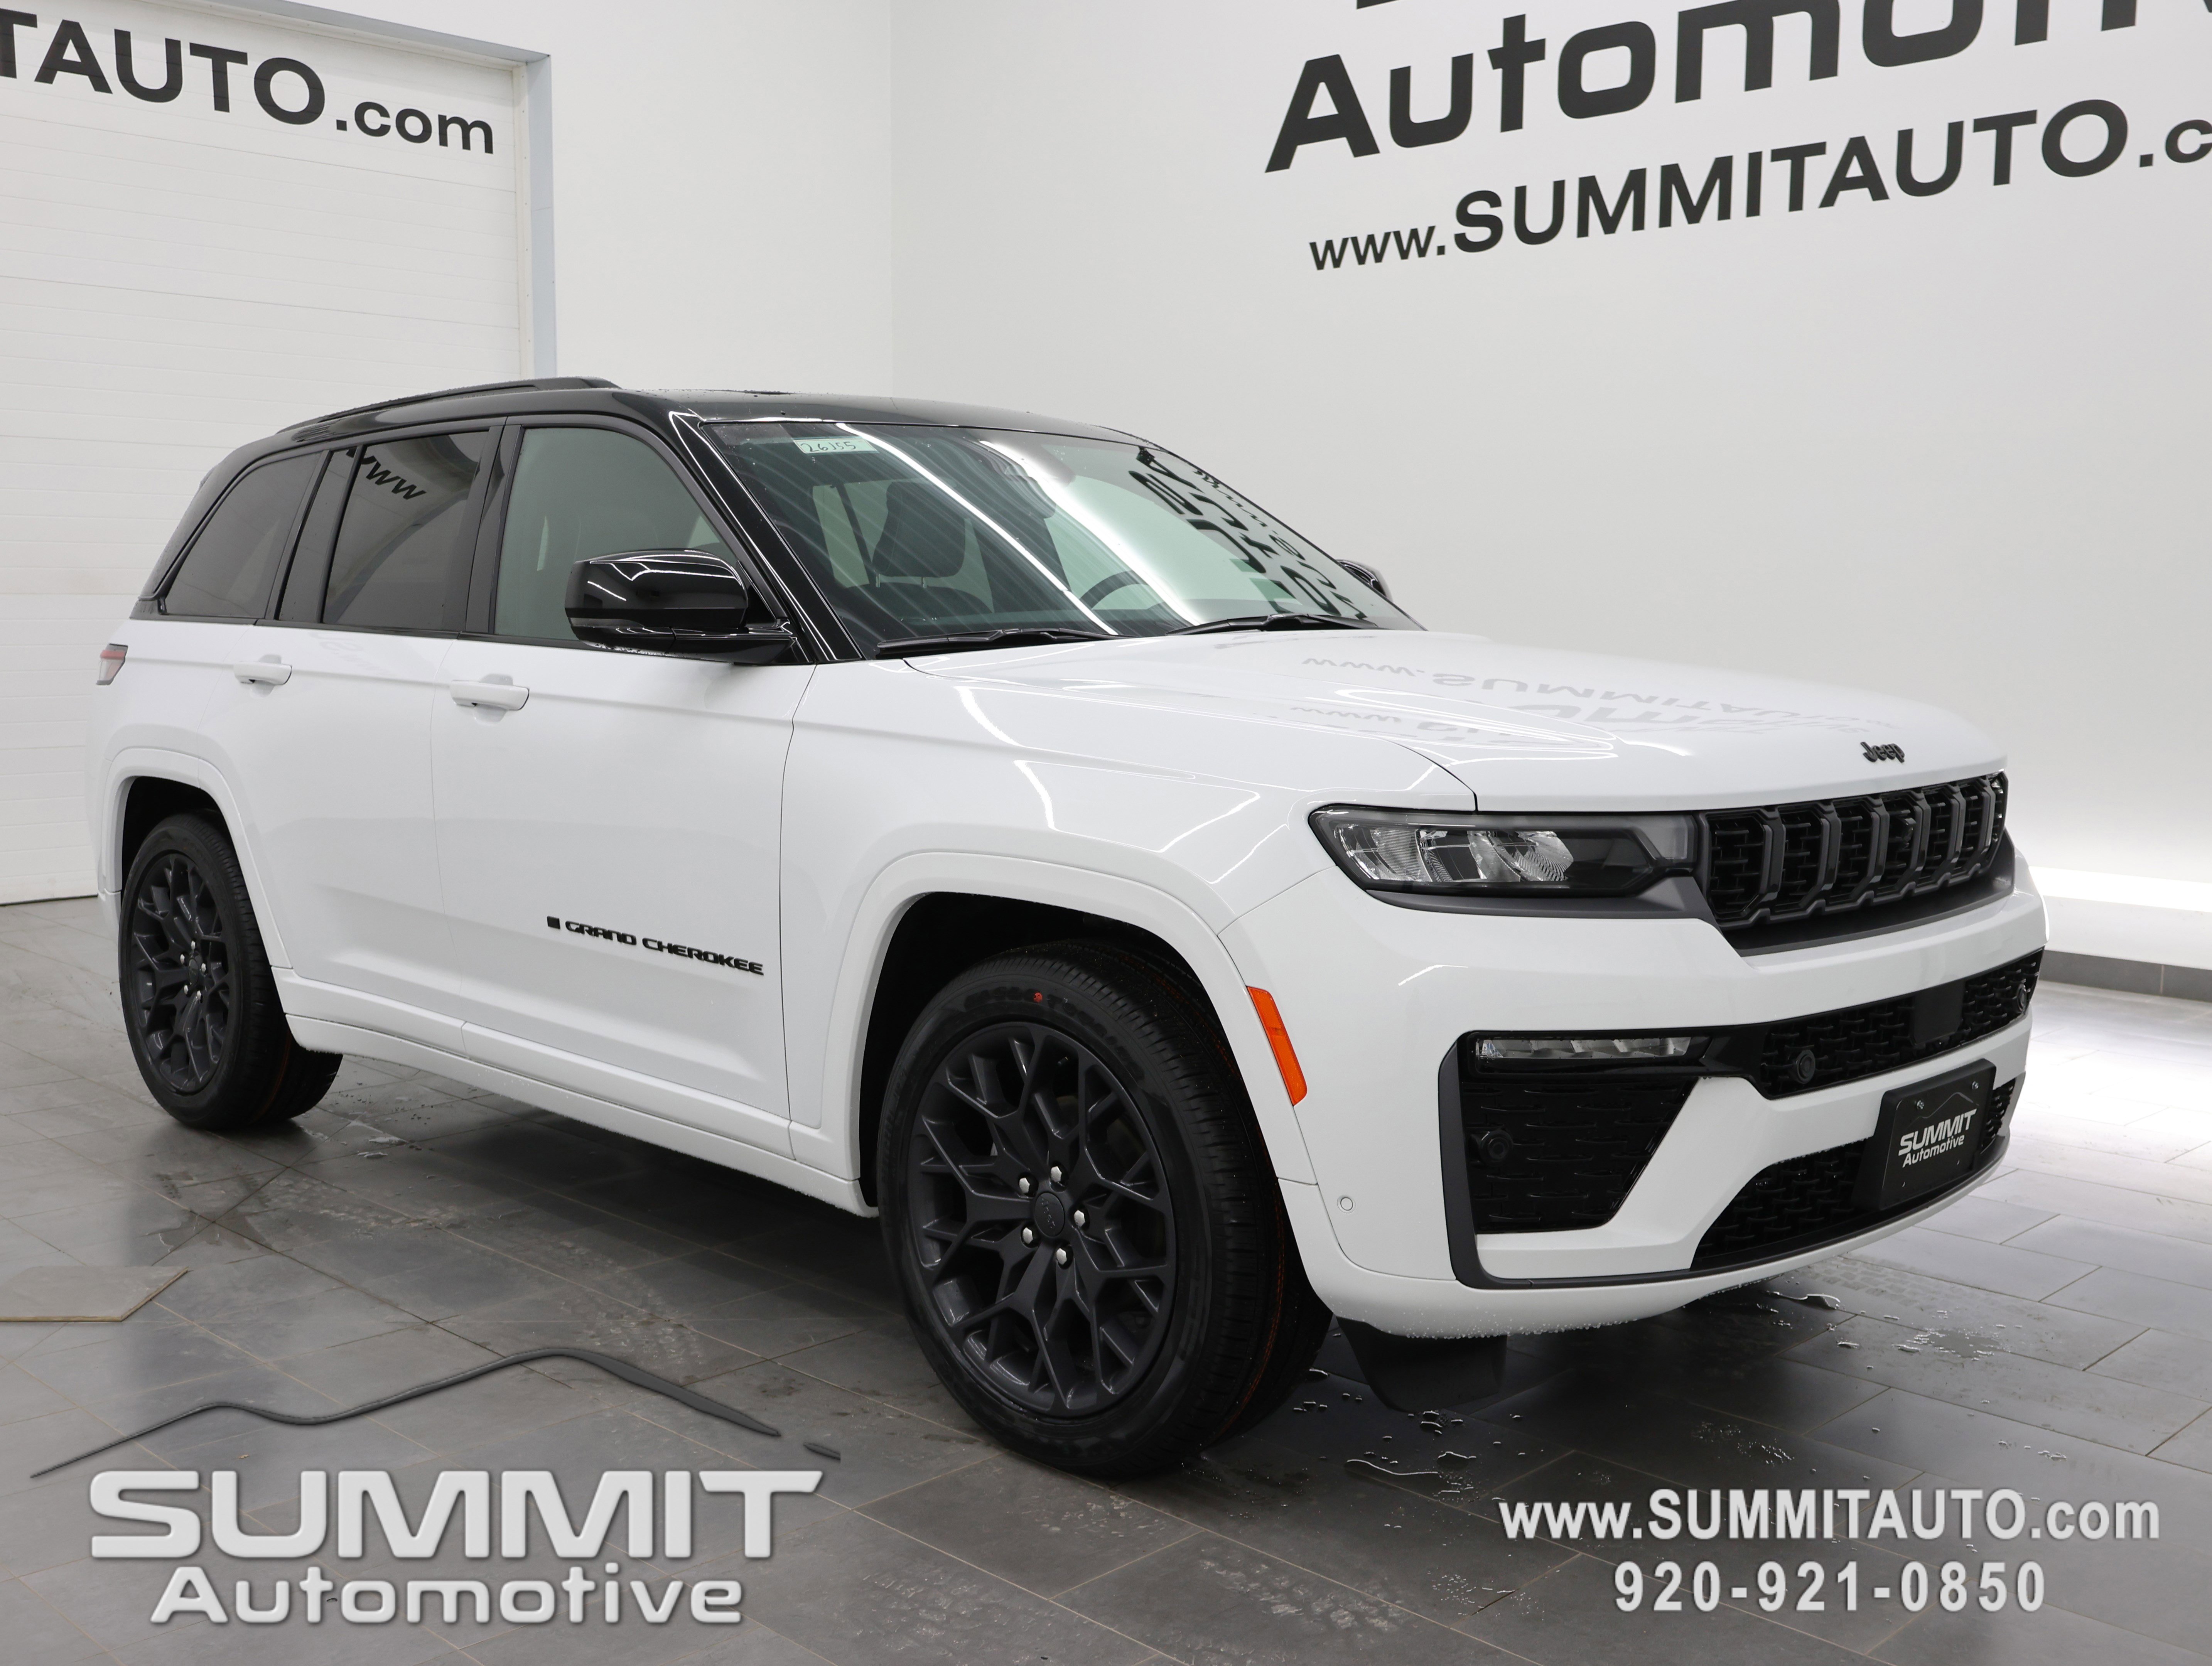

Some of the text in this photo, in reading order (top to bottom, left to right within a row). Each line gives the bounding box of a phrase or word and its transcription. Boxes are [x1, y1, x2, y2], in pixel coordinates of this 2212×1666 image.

[1264, 0, 2212, 173] Automo
[1309, 99, 2212, 271] www.SUMMITAUTO.c
[1860, 741, 1905, 763] Jeep
[565, 920, 764, 976] GRAND CHEROKEE
[1898, 1108, 1977, 1156] SUMMIT
[1902, 1134, 1965, 1168] Automotive
